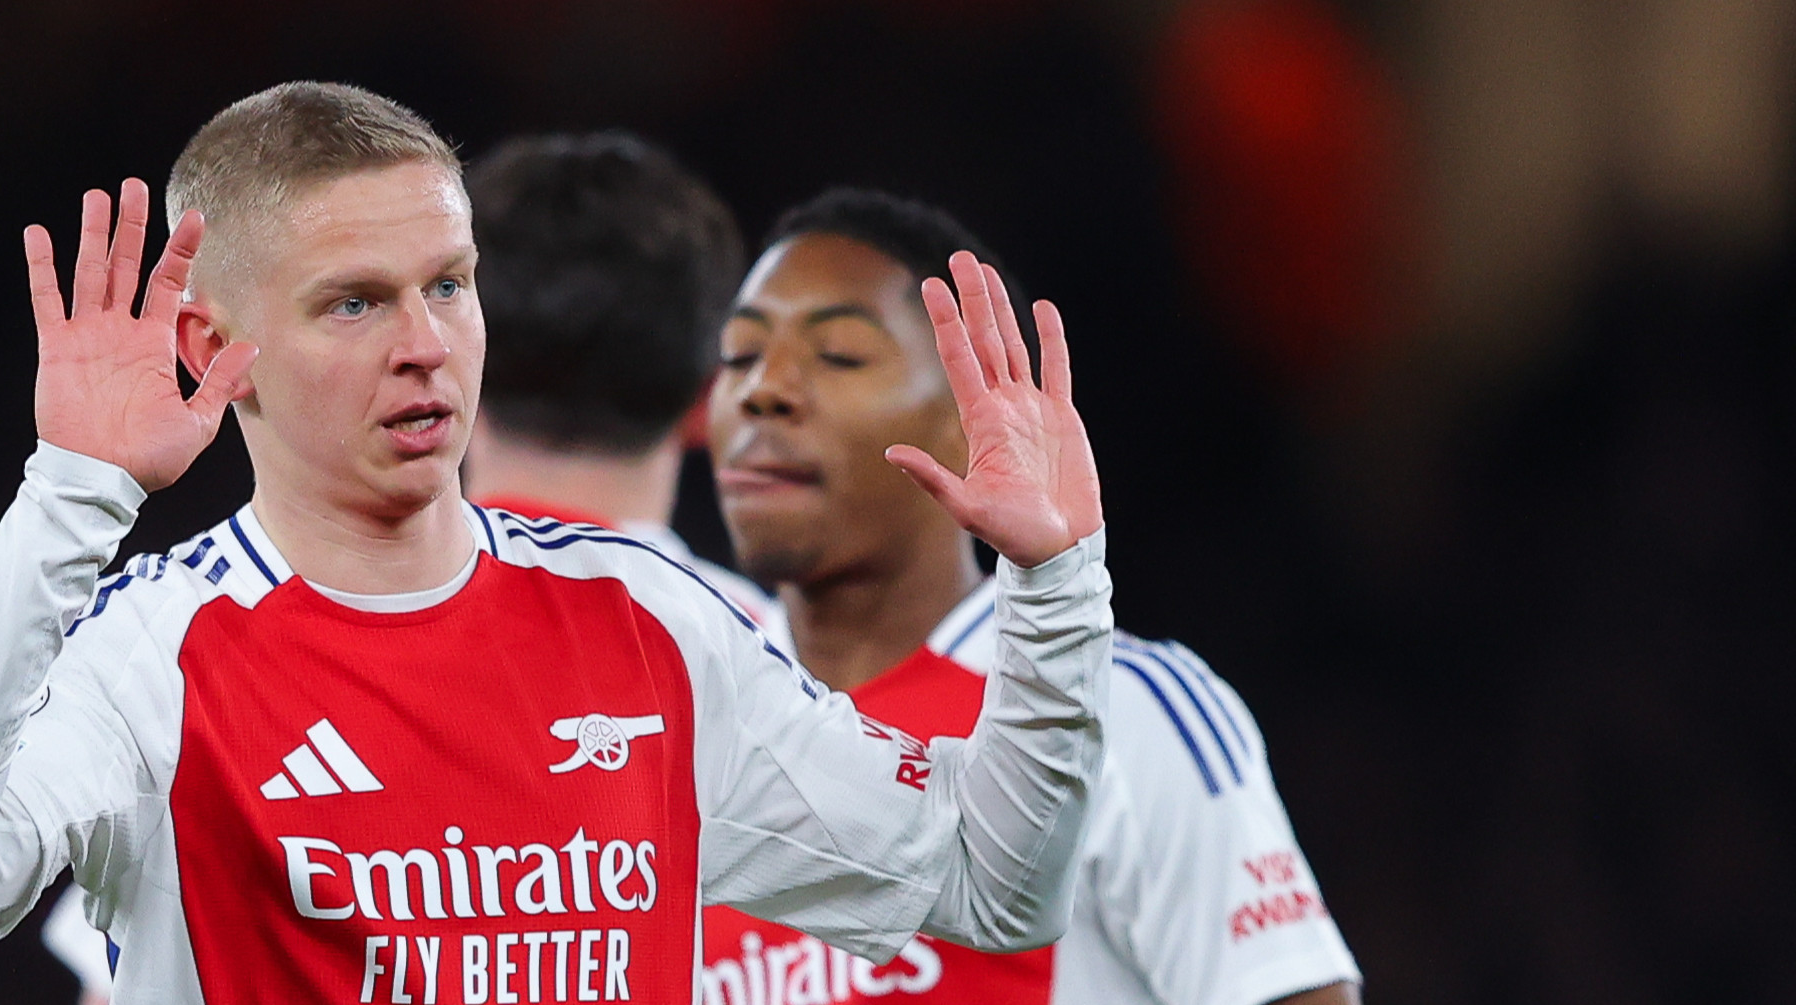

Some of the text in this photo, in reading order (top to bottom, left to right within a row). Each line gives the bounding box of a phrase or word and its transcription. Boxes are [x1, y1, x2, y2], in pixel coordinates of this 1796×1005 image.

[277, 825, 657, 920] Emirates
[359, 928, 631, 1005] FLY BETTER
